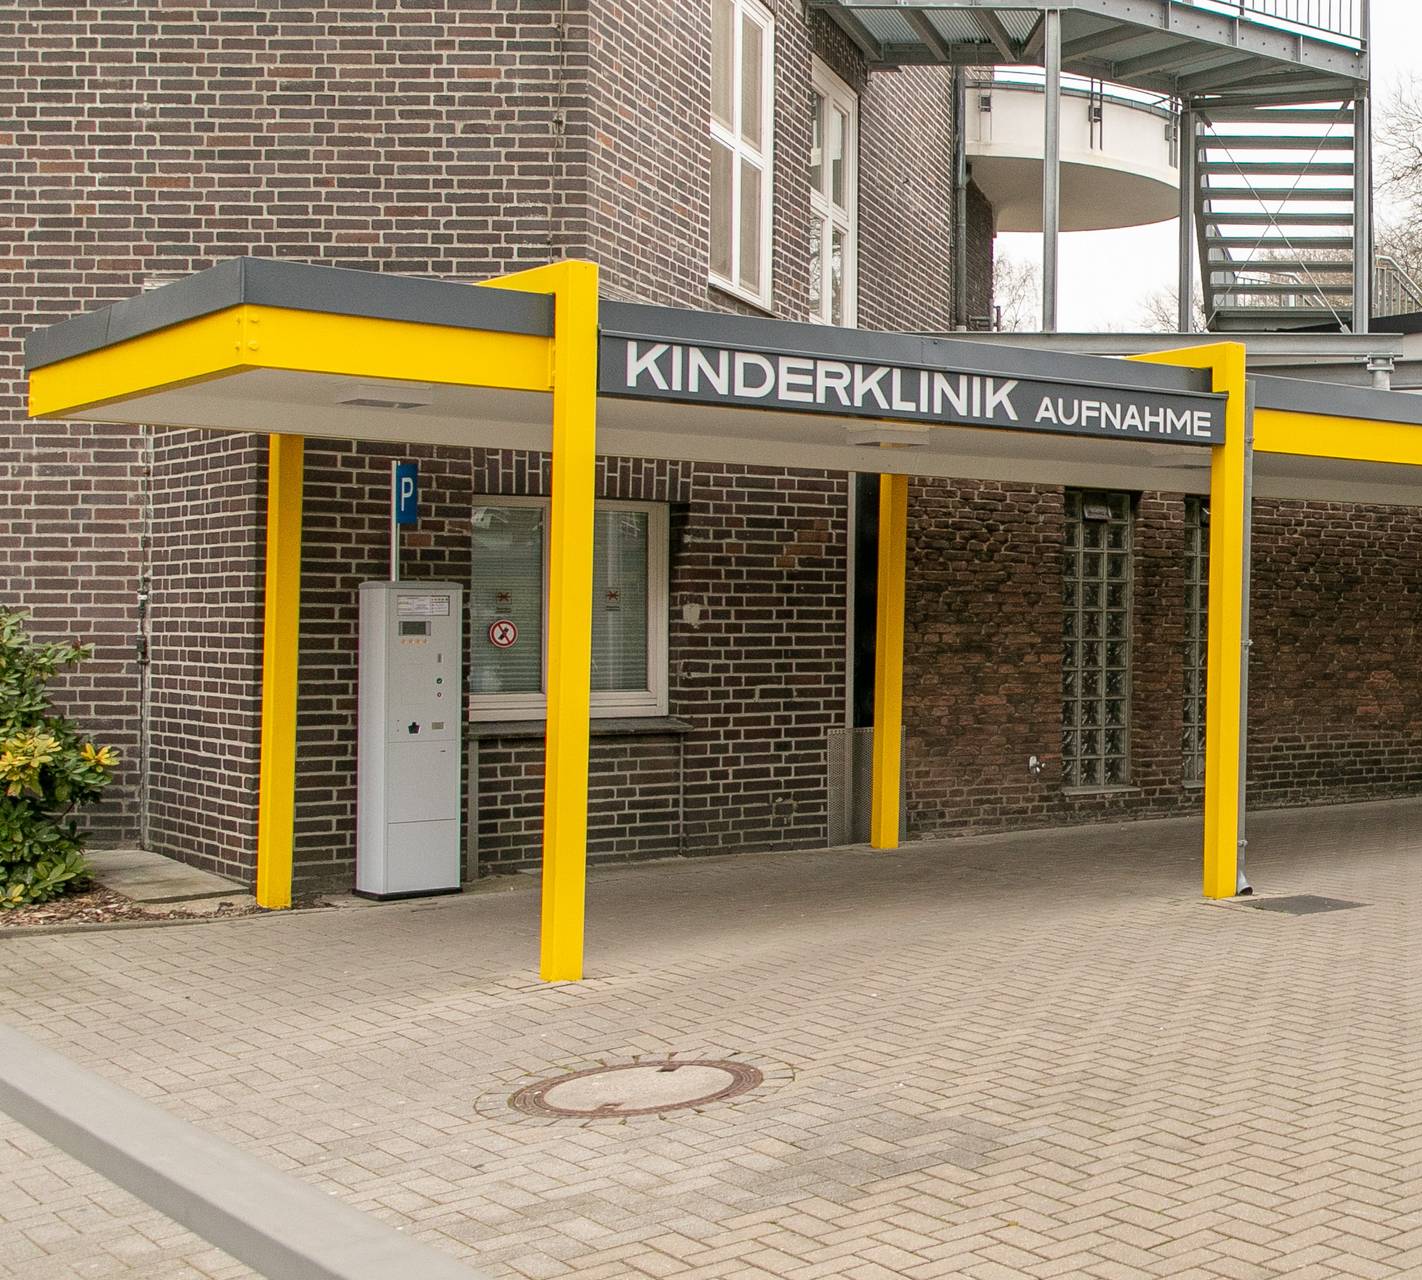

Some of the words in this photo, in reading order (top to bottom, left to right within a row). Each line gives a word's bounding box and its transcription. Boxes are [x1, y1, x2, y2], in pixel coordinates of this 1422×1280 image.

[626, 341, 1020, 421] KINDERKLINIK
[1034, 396, 1212, 437] AUFNAHME
[401, 477, 414, 512] P
